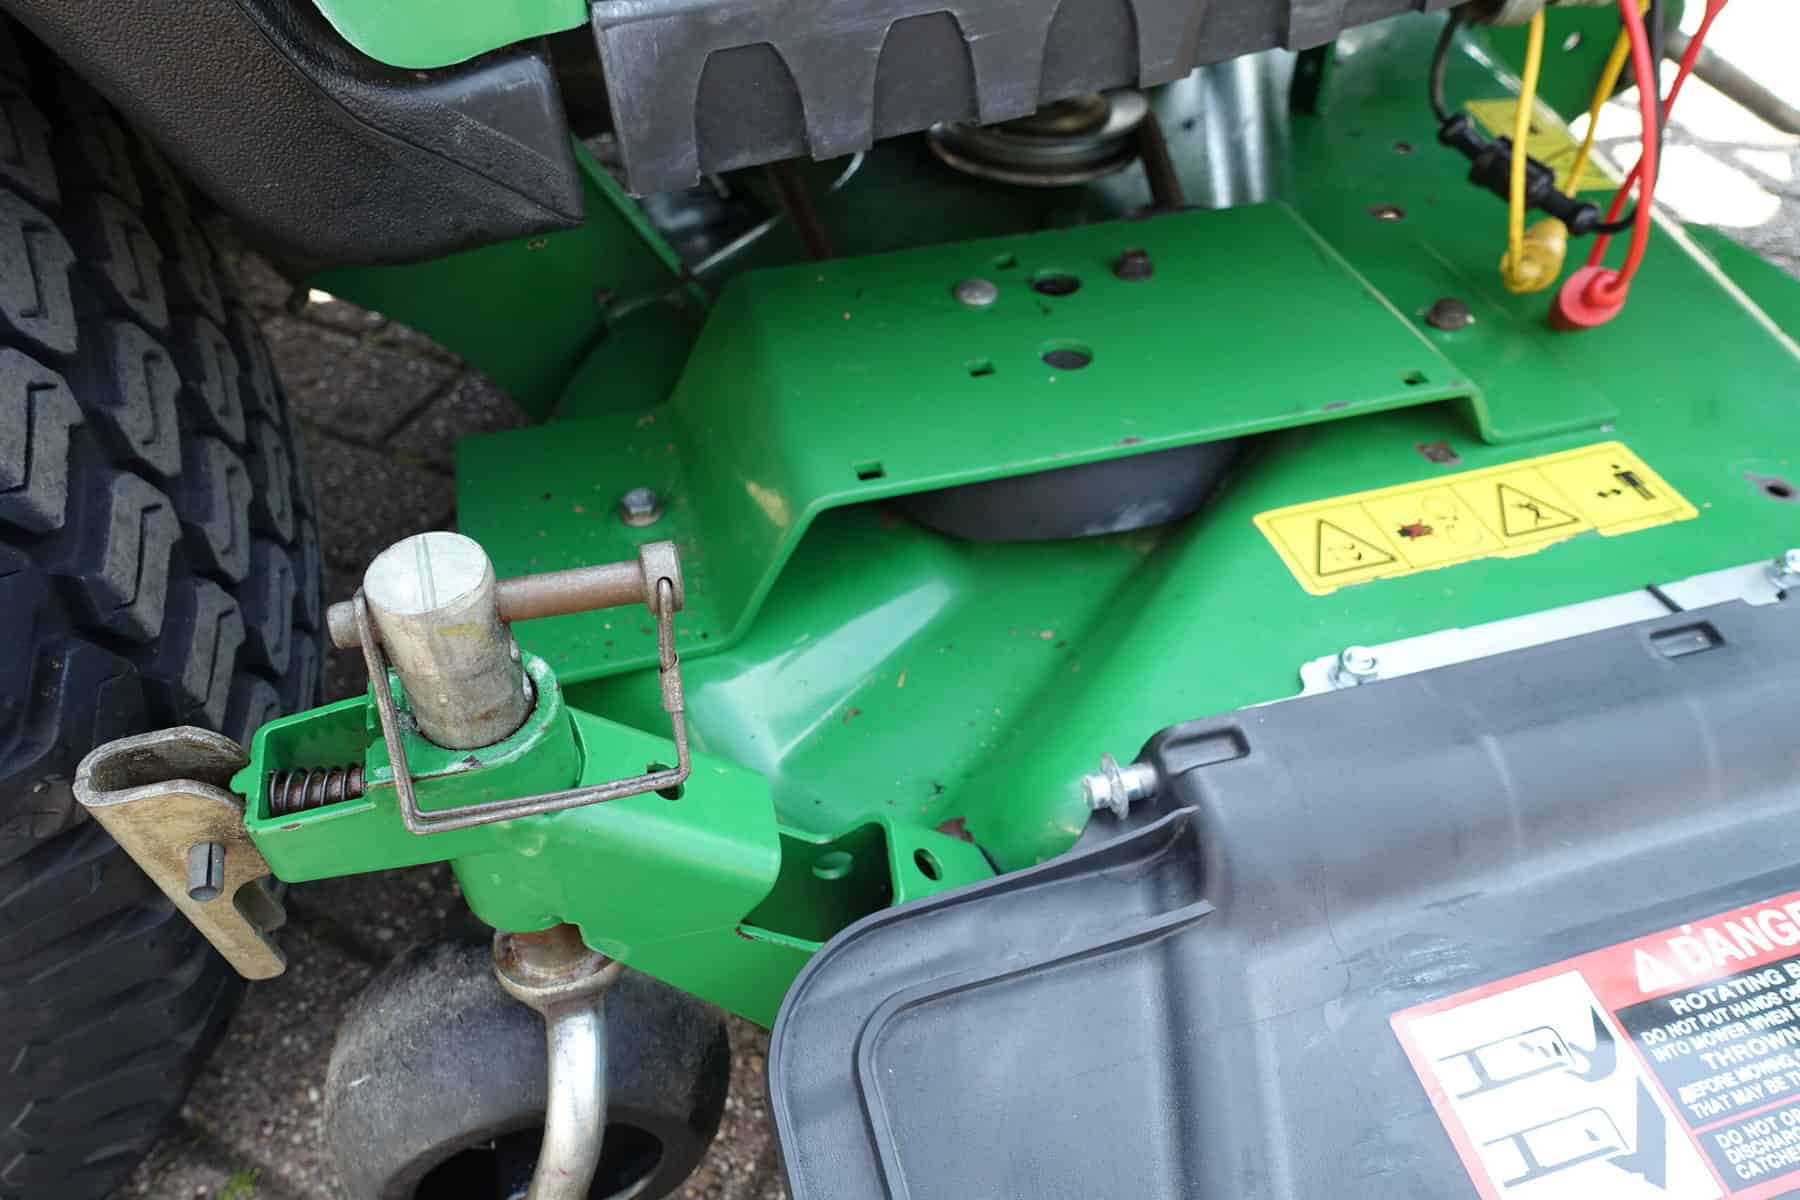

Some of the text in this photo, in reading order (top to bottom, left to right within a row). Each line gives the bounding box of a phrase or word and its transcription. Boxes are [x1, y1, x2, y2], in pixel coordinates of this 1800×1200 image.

[1669, 960, 1800, 1016] ROTATING B
[1640, 1027, 1667, 1046] DO
[1665, 1016, 1700, 1038] NOT
[1699, 1007, 1731, 1030] PUT
[1729, 991, 1783, 1018] HANDS
[1651, 1041, 1691, 1062] INTO
[1688, 1021, 1749, 1050] MOWER
[1746, 1006, 1795, 1032] WHEN
[1699, 1026, 1800, 1070] THROWN
[1678, 1072, 1739, 1105] BEFORE
[1688, 1093, 1732, 1119] THAT
[1730, 1082, 1763, 1106] MAY
[1763, 1075, 1790, 1095] BE
[1714, 1129, 1743, 1149] DO
[1741, 1116, 1779, 1140] NOT
